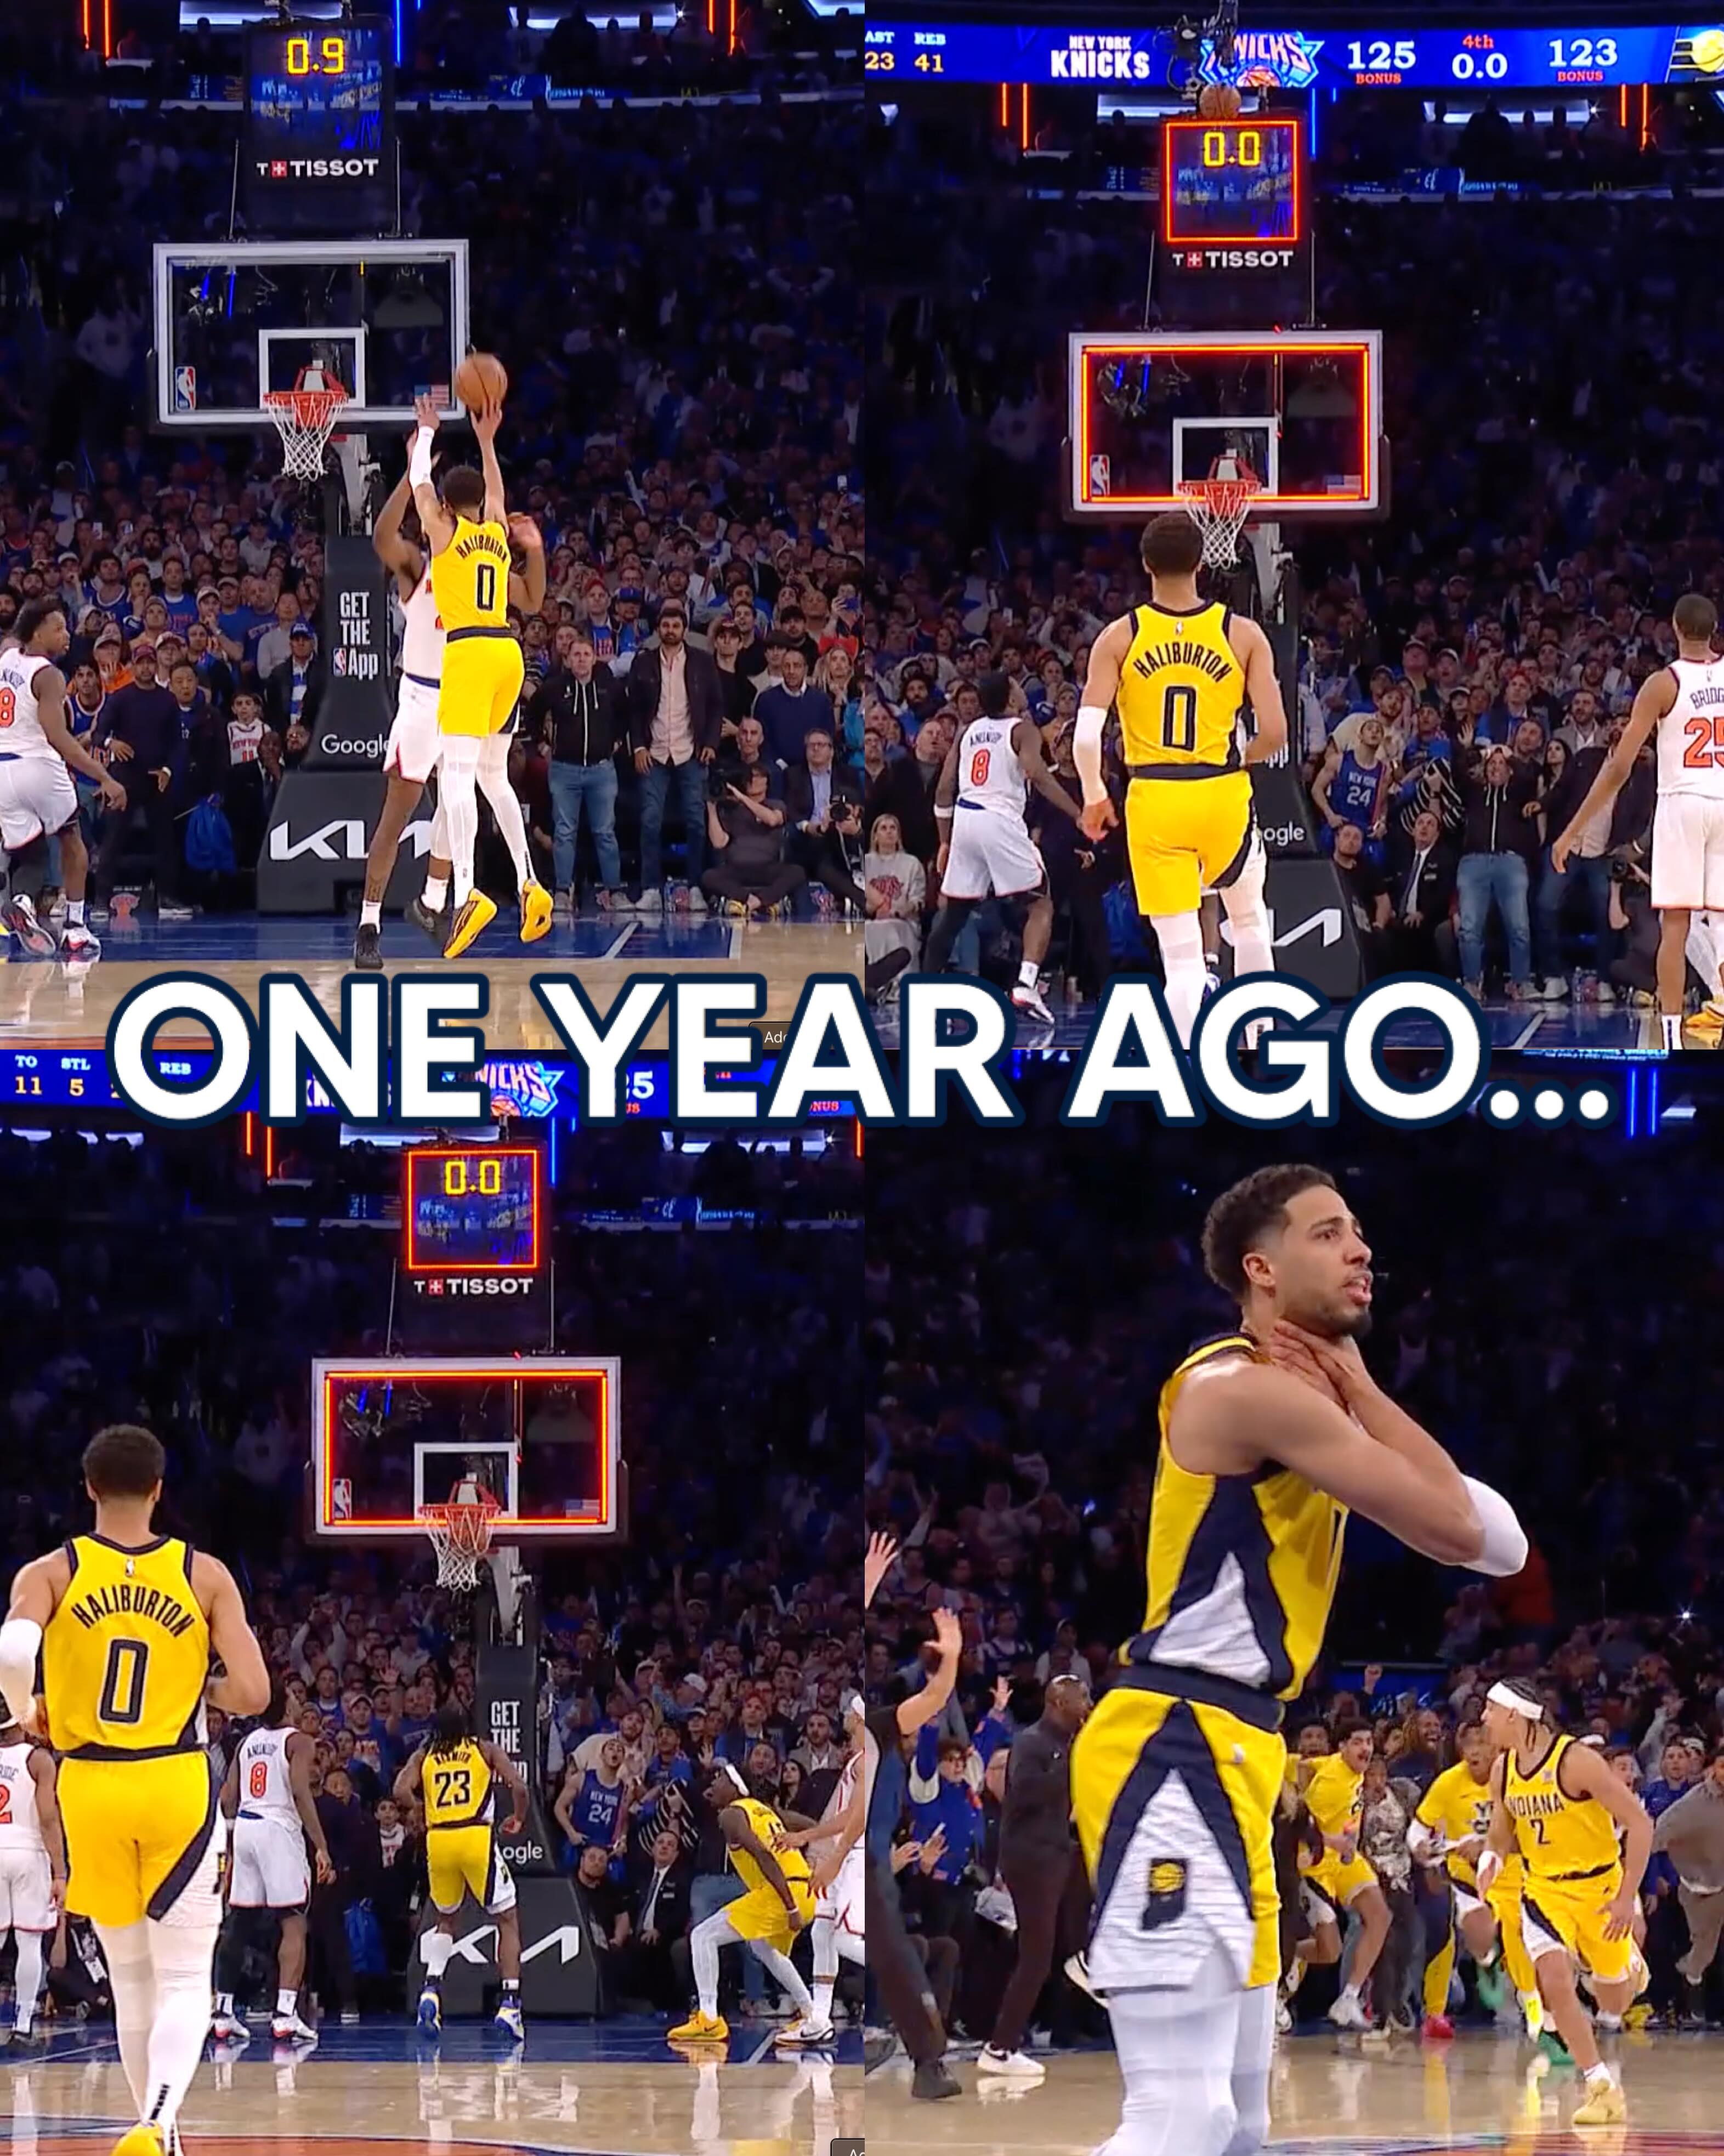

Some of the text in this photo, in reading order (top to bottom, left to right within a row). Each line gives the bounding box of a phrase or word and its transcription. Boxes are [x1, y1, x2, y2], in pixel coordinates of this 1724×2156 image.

[865, 30, 946, 46] AST REB
[1069, 35, 1132, 51] NEW YORK
[1462, 35, 1494, 49] 4th
[287, 38, 345, 75] 0.9
[864, 50, 944, 73] 23 41
[1051, 49, 1150, 79] KNICKS
[1206, 31, 1312, 73] NICKS
[1347, 40, 1416, 70] 125
[1549, 38, 1618, 67] 123
[1356, 72, 1402, 84] BONUS
[1451, 53, 1508, 80] 0.0
[1557, 70, 1603, 82] BONUS
[1204, 131, 1260, 167] 0.0
[290, 158, 379, 177] TISSOT
[1205, 250, 1294, 268] TISSOT
[477, 563, 495, 611] 0
[340, 592, 370, 618] GET
[340, 619, 371, 645] THE
[348, 648, 379, 680] App
[1133, 641, 1233, 683] HALIBURTON
[1689, 686, 1724, 710] BRIDG
[1162, 685, 1197, 752] 0
[971, 749, 991, 787] 8
[1347, 785, 1371, 807] 24
[1263, 821, 1305, 847] ogle
[15, 1054, 191, 1075] TO STL REB
[15, 1076, 84, 1097] 11 5
[475, 1062, 552, 1103] NICKS
[809, 1100, 840, 1112] NUS
[445, 1160, 501, 1195] 0.0
[446, 1278, 534, 1295] TISSOT
[71, 1584, 196, 1638] HALIBURTON
[99, 1638, 149, 1724] 0
[491, 1701, 520, 1727] GET
[490, 1728, 521, 1754] THE
[250, 1761, 268, 1798] 8
[435, 1769, 470, 1809] 23
[587, 1803, 613, 1825] 24
[1507, 1791, 1564, 1817] NDIANA
[1530, 1818, 1552, 1845] 2
[502, 1840, 543, 1864] ogle
